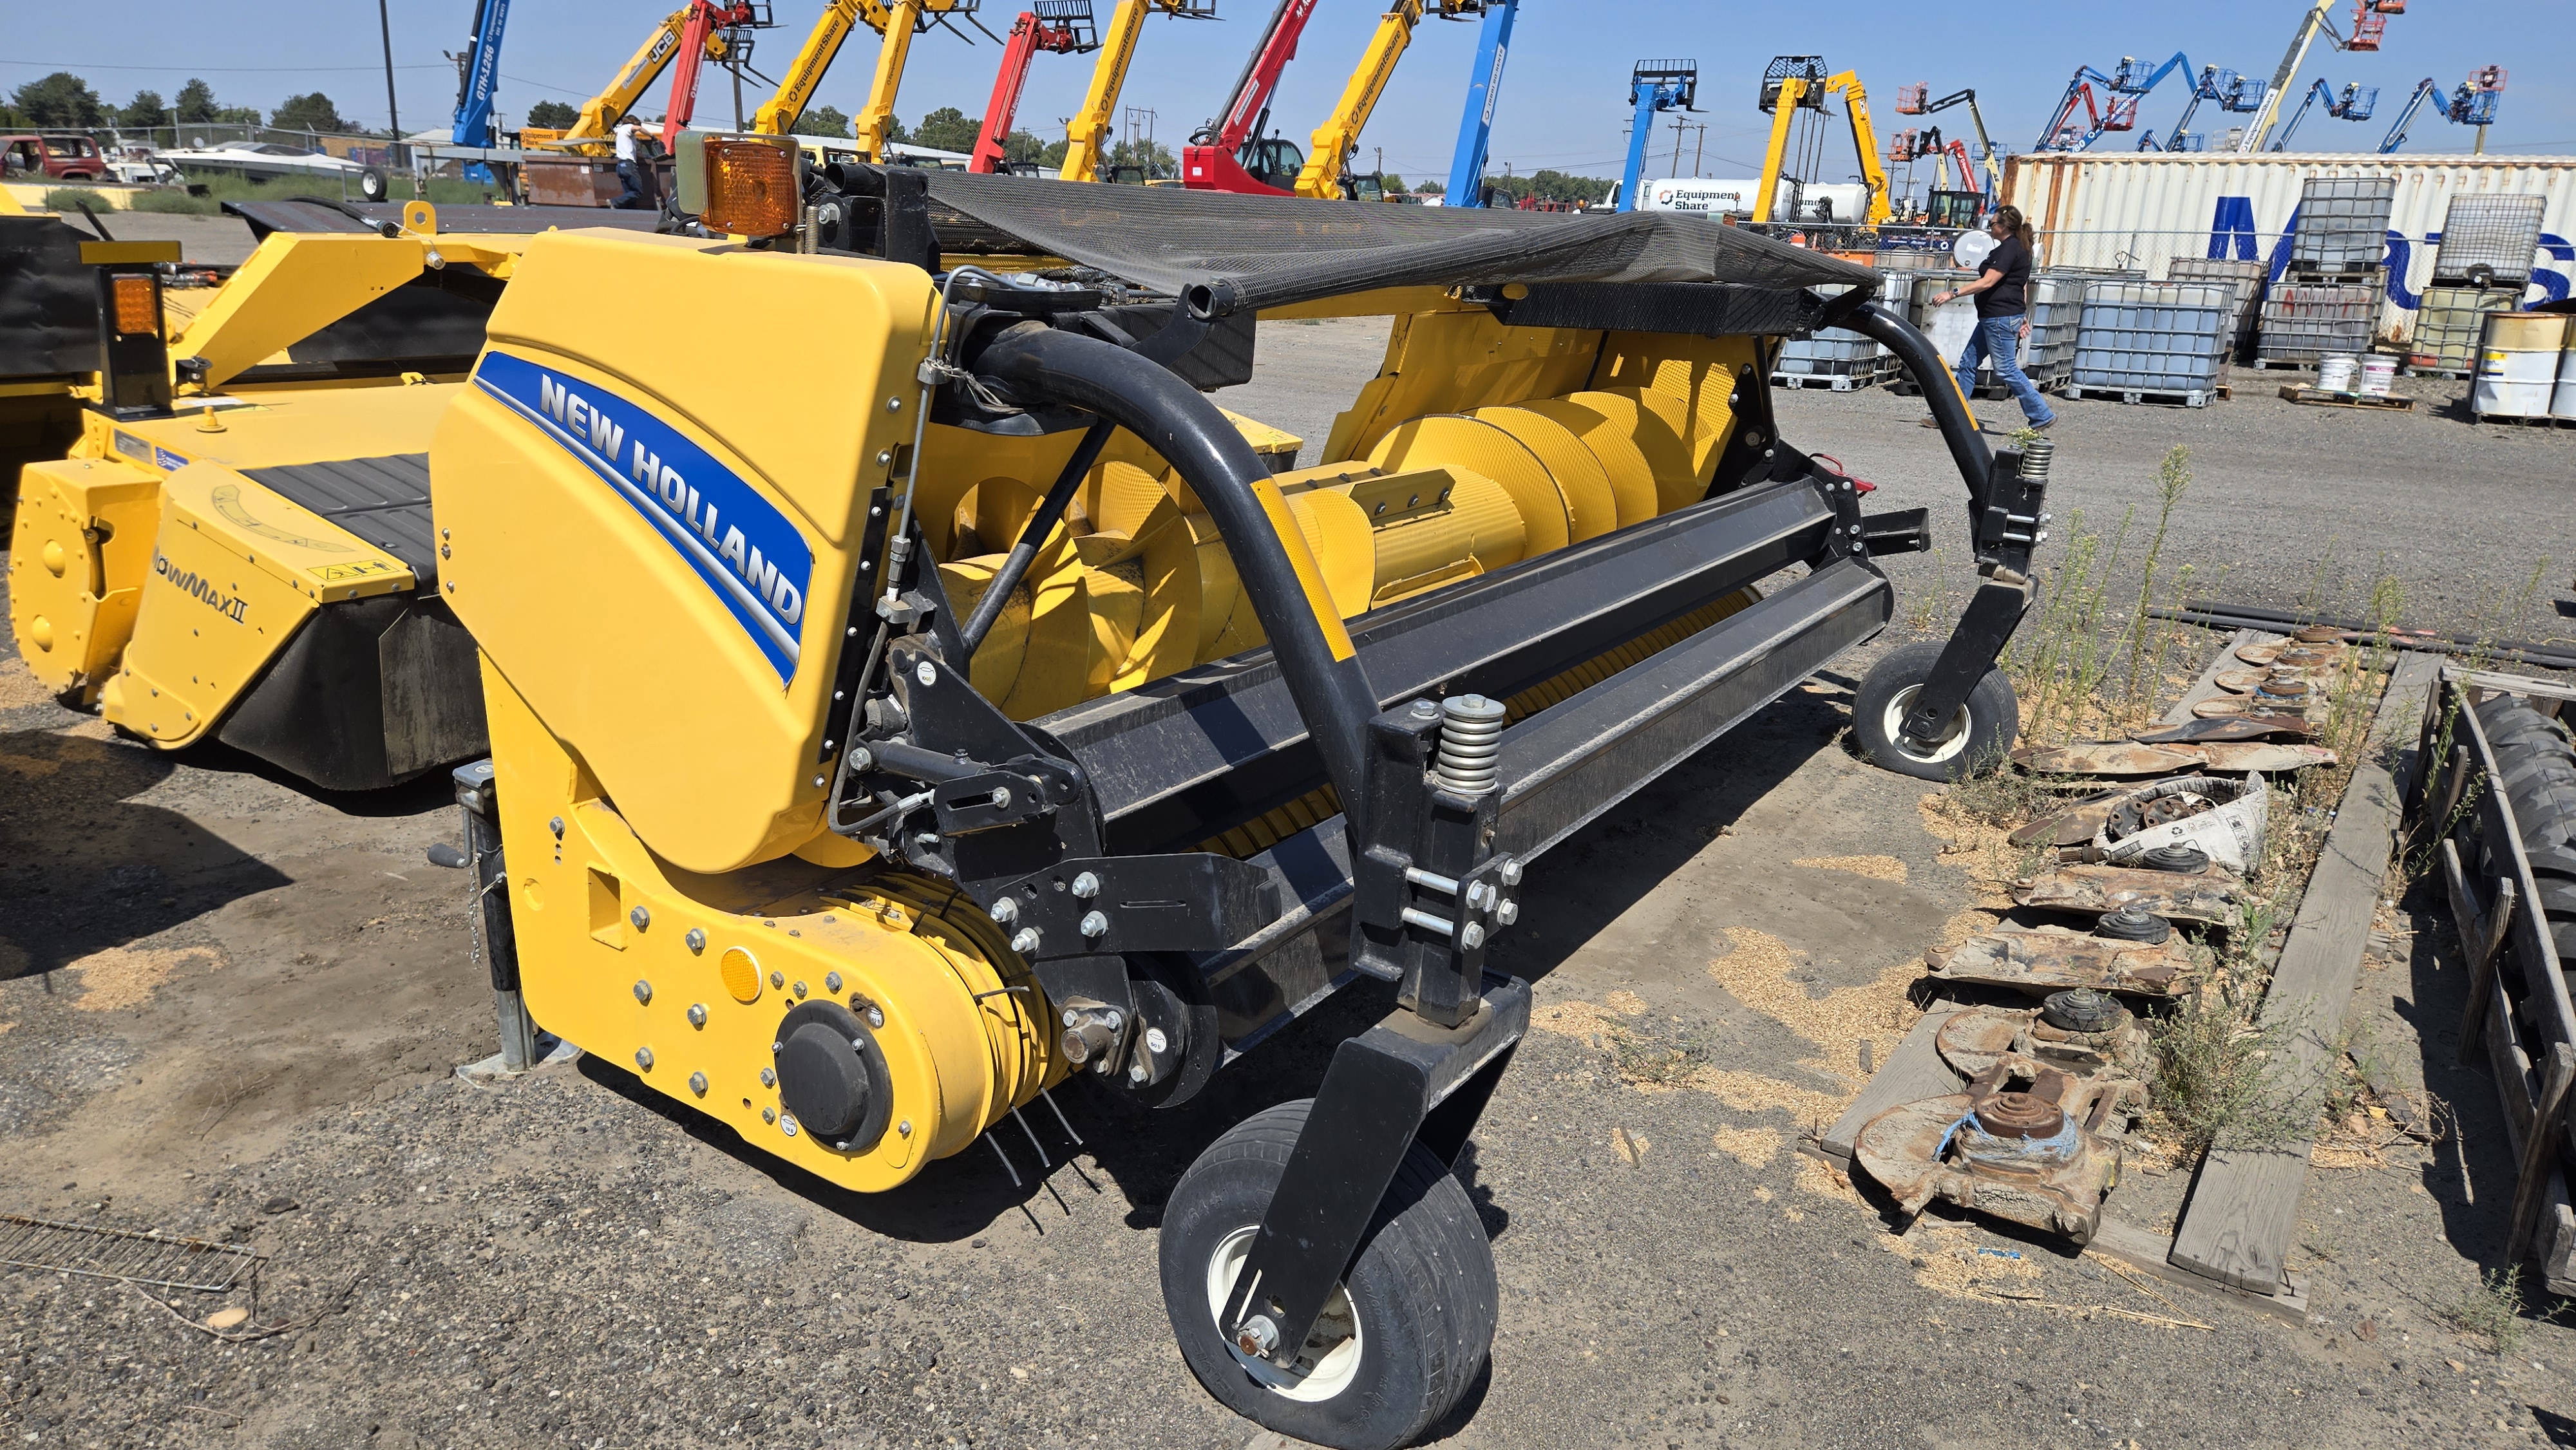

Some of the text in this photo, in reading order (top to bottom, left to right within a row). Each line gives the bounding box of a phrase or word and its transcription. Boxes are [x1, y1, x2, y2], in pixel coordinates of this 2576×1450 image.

[477, 44, 494, 101] GTH-1256
[652, 30, 676, 62] JCB
[794, 19, 840, 93] EquipmentShare
[889, 39, 902, 80] EquipmentShare
[1105, 7, 1139, 100] EquipmentShare
[1357, 30, 1401, 114] EquipmentShare
[1012, 57, 1031, 110] EquipmentShare
[1238, 82, 1258, 118] EquipmentShare
[1858, 98, 1866, 115] JCB
[2245, 93, 2274, 146] EquipmentShare
[1675, 201, 1709, 210] Share
[1676, 190, 1736, 201] Equipmen
[540, 373, 802, 625] NEW HOLLAND
